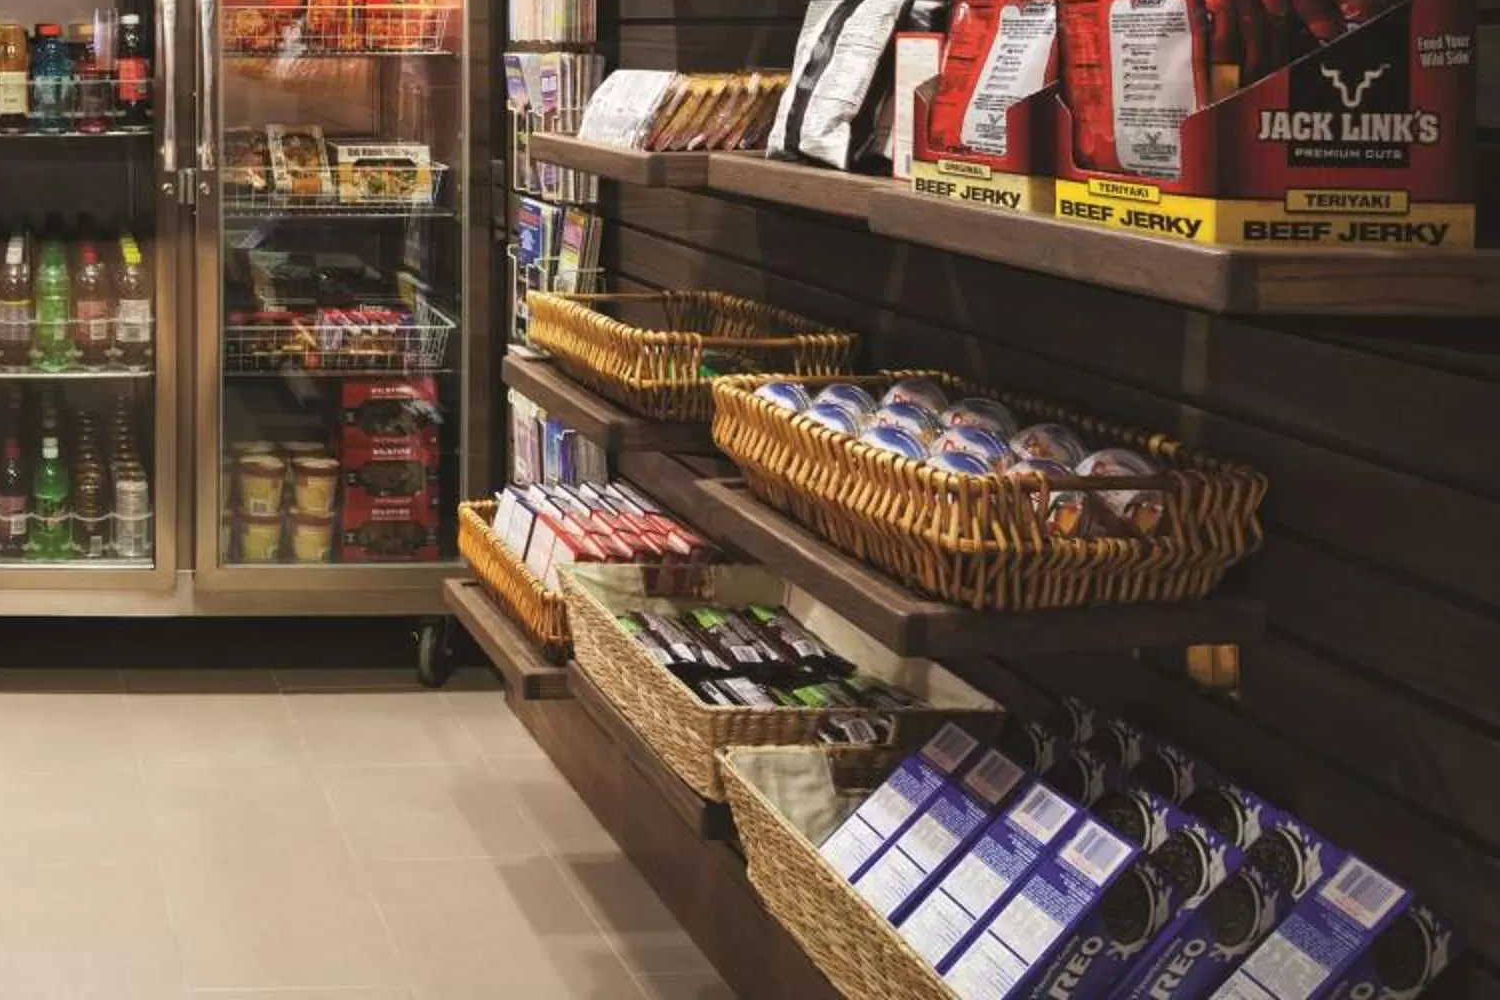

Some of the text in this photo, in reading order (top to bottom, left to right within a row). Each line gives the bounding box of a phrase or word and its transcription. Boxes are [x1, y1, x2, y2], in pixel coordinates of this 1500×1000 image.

[1444, 33, 1471, 49] Your
[1257, 109, 1440, 143] JACK LINK'S
[1294, 147, 1403, 160] PREMIUM CUTS
[915, 177, 1021, 209] BEEF JERKY
[1099, 181, 1150, 199] TERIYAKI
[1304, 193, 1392, 209] TERIYAKI
[1060, 198, 1203, 240] BEEF JERKY
[1242, 220, 1450, 247] BEEF JERKY
[1048, 935, 1104, 1000] REO
[1150, 938, 1207, 1000] REO
